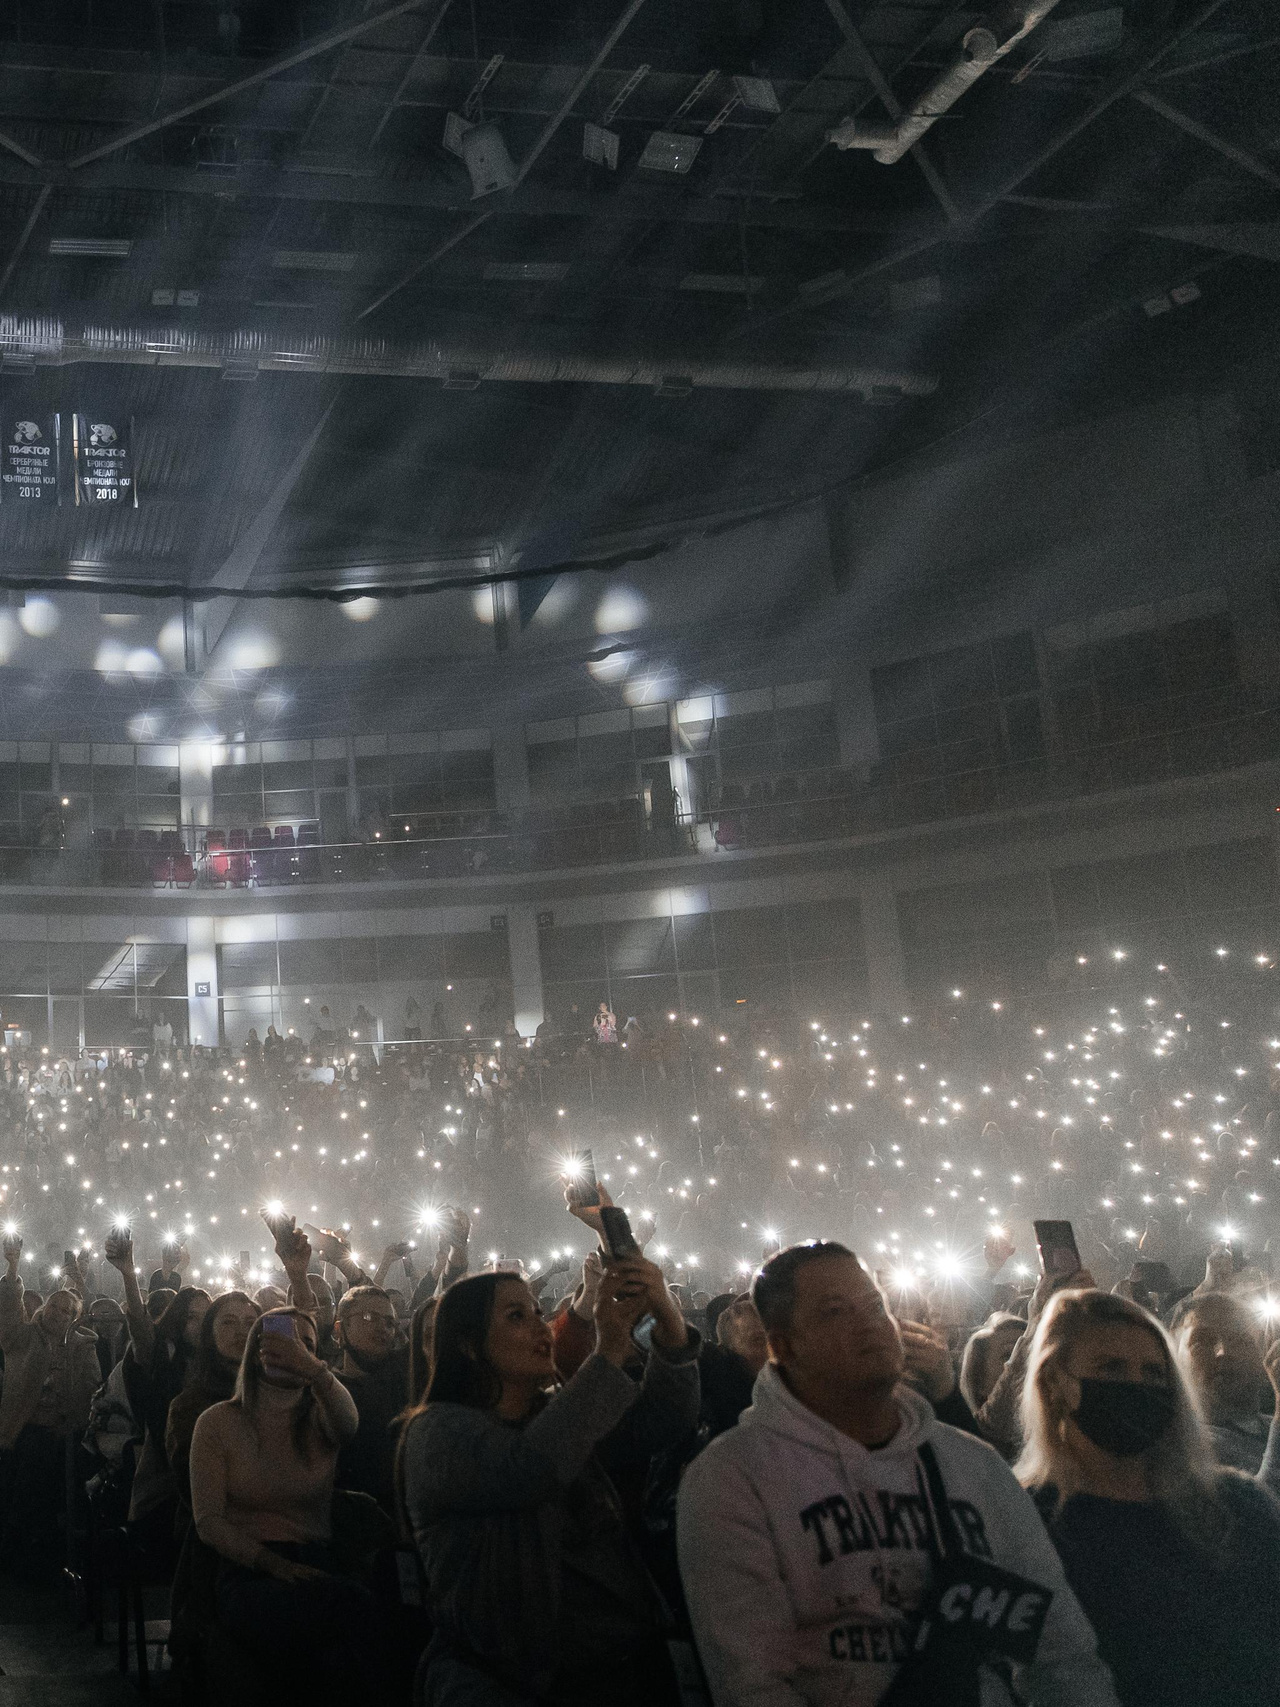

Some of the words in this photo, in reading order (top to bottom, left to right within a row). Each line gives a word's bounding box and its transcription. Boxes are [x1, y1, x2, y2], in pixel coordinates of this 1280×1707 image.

[8, 445, 51, 455] TRAKTOR
[83, 448, 126, 458] TRAKTOR
[19, 486, 41, 498] 2013
[96, 488, 118, 500] 2018
[798, 1489, 995, 1566] TRAKTR
